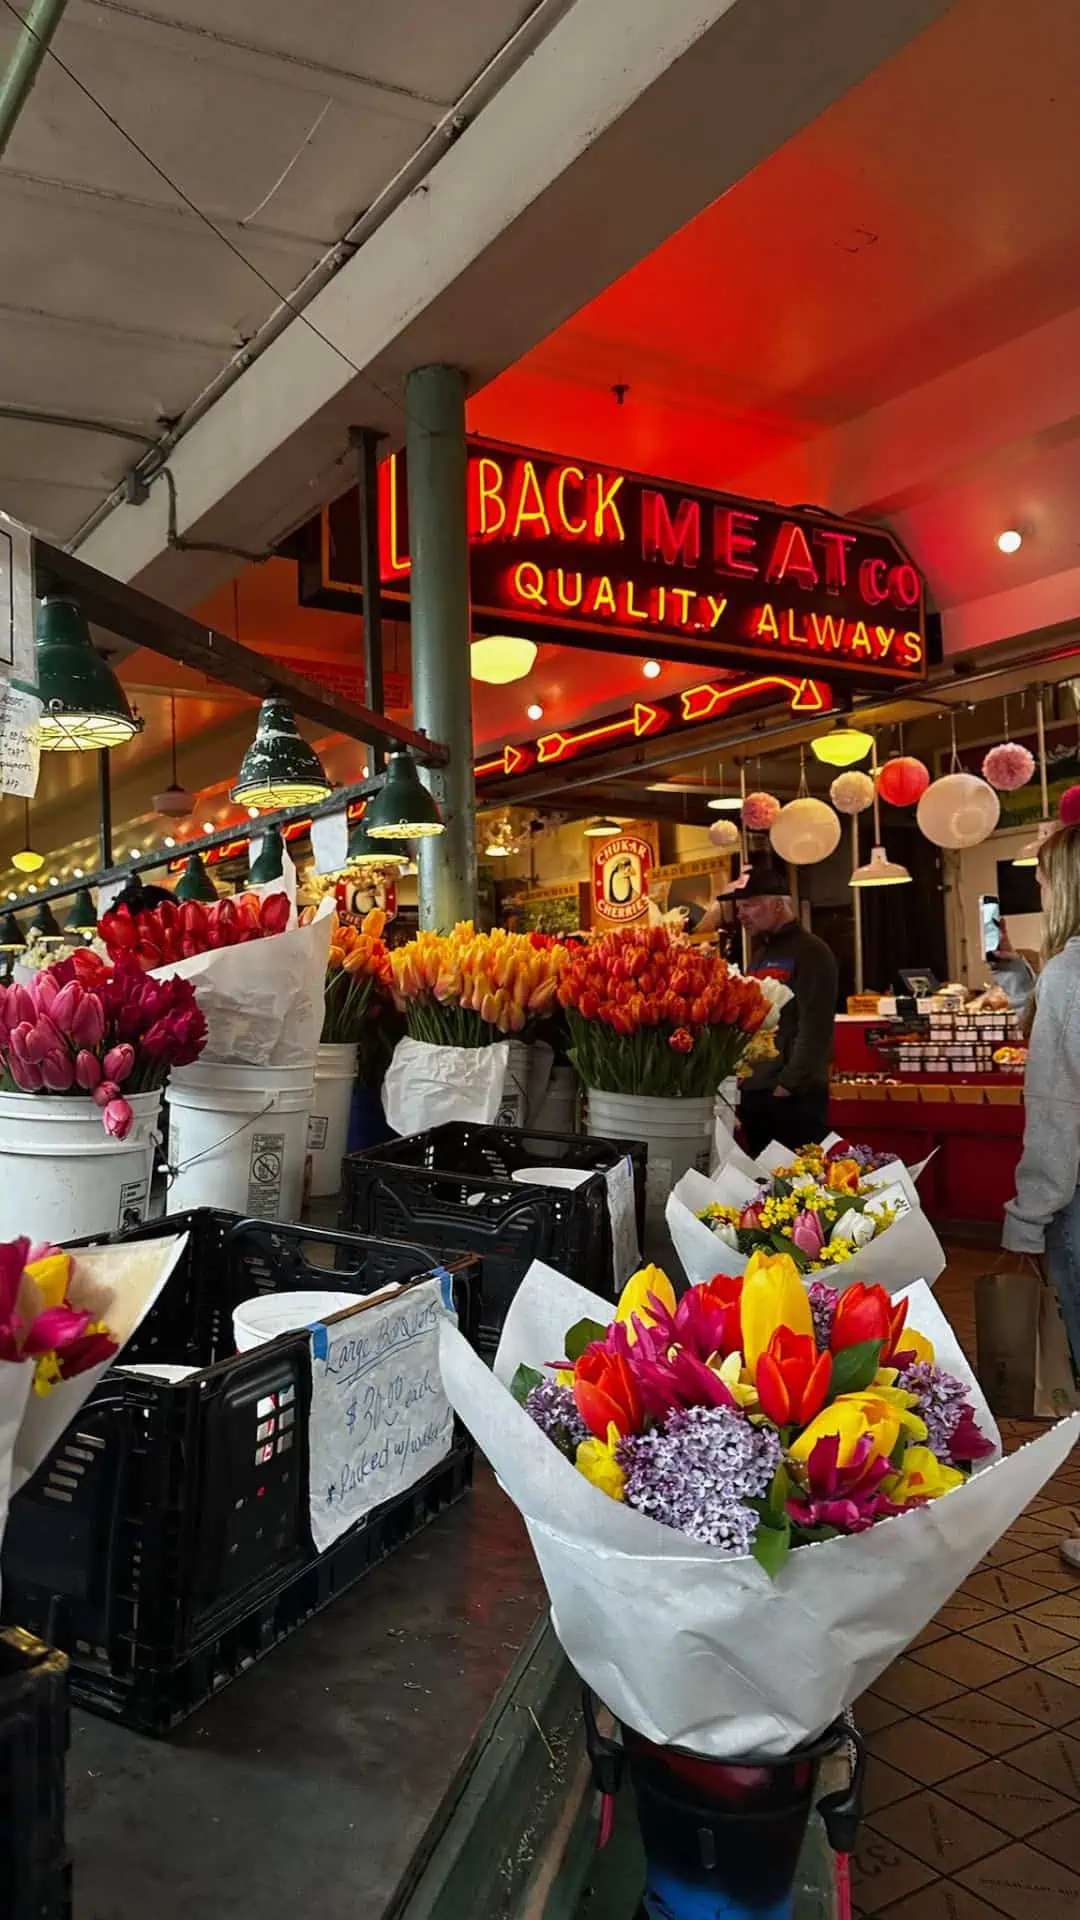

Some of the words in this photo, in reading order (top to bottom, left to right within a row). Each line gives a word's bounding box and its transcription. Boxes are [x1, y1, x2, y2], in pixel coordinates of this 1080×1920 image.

[642, 490, 857, 594] MEAT
[860, 557, 921, 608] CO
[514, 562, 728, 629] QUALITY
[756, 602, 923, 664] ALWAYS
[597, 839, 648, 865] CHUKAR
[325, 1338, 370, 1377] Large
